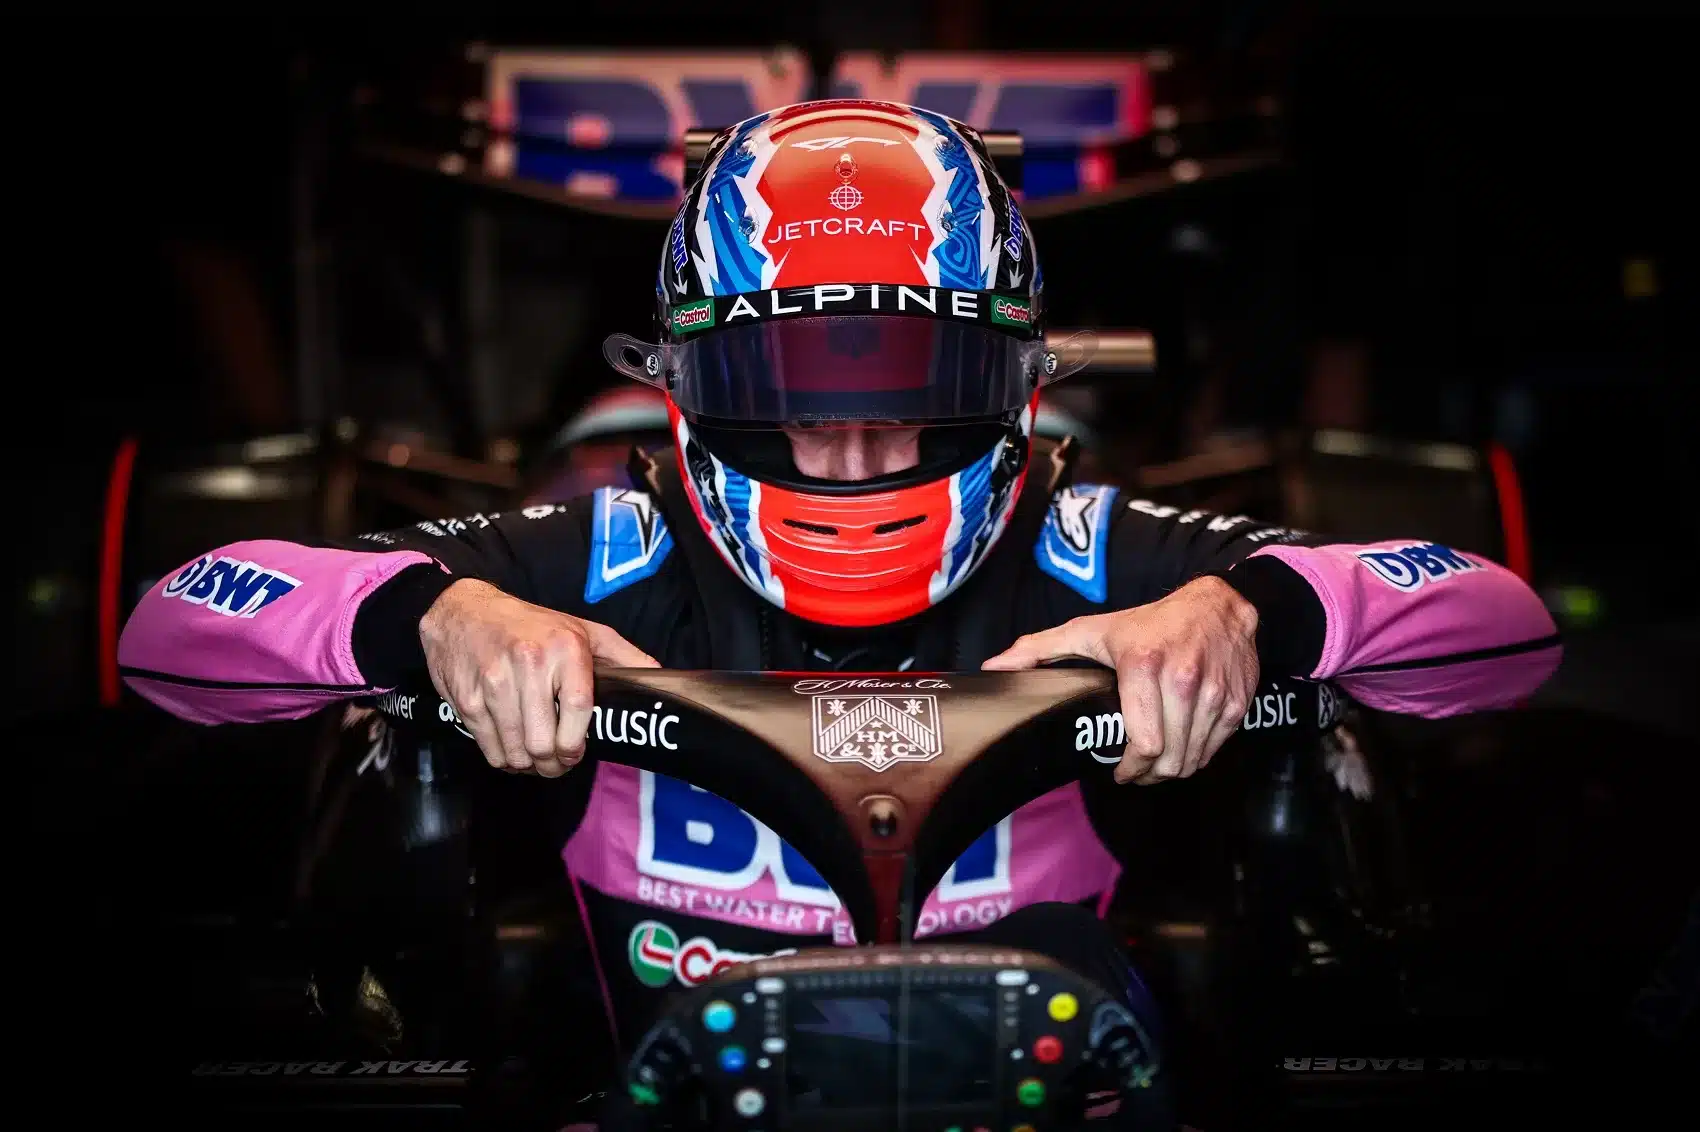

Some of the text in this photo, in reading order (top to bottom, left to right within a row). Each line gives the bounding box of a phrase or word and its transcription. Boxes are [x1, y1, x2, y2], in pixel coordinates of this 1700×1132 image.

[767, 217, 926, 245] JETCRAFT
[680, 304, 710, 327] Castrol
[724, 284, 979, 324] ALPINE
[184, 557, 300, 617] BWT
[1242, 683, 1298, 731] usic
[840, 742, 864, 757] &
[857, 731, 899, 743] HM
[637, 876, 700, 911] BEST
[706, 893, 805, 930] WATER
